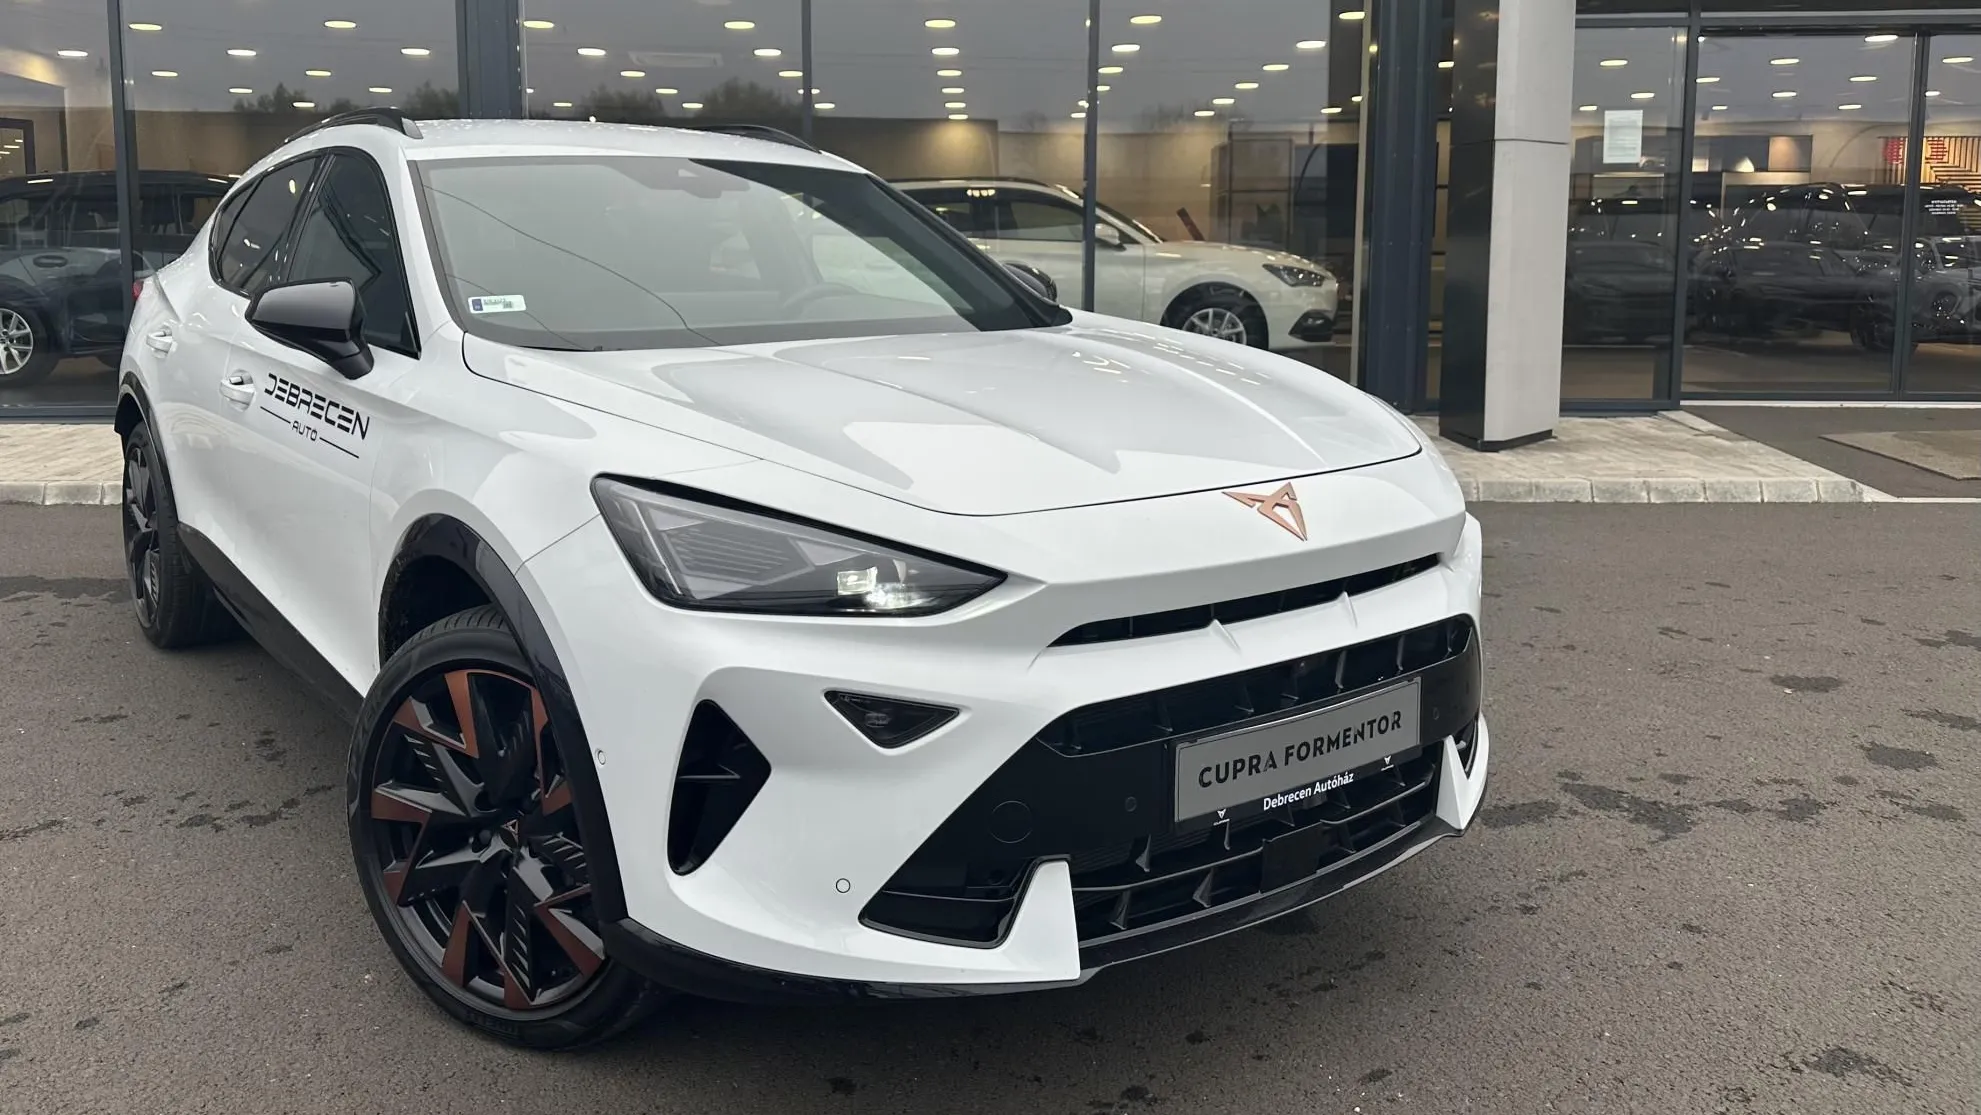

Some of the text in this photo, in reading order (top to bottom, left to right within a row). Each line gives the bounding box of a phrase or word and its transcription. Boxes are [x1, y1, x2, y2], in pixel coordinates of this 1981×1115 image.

[264, 372, 370, 440] DEBRECEN
[1198, 710, 1402, 788] CUPRA FORMENTOR
[1263, 771, 1354, 811] Debrecen Autóház
